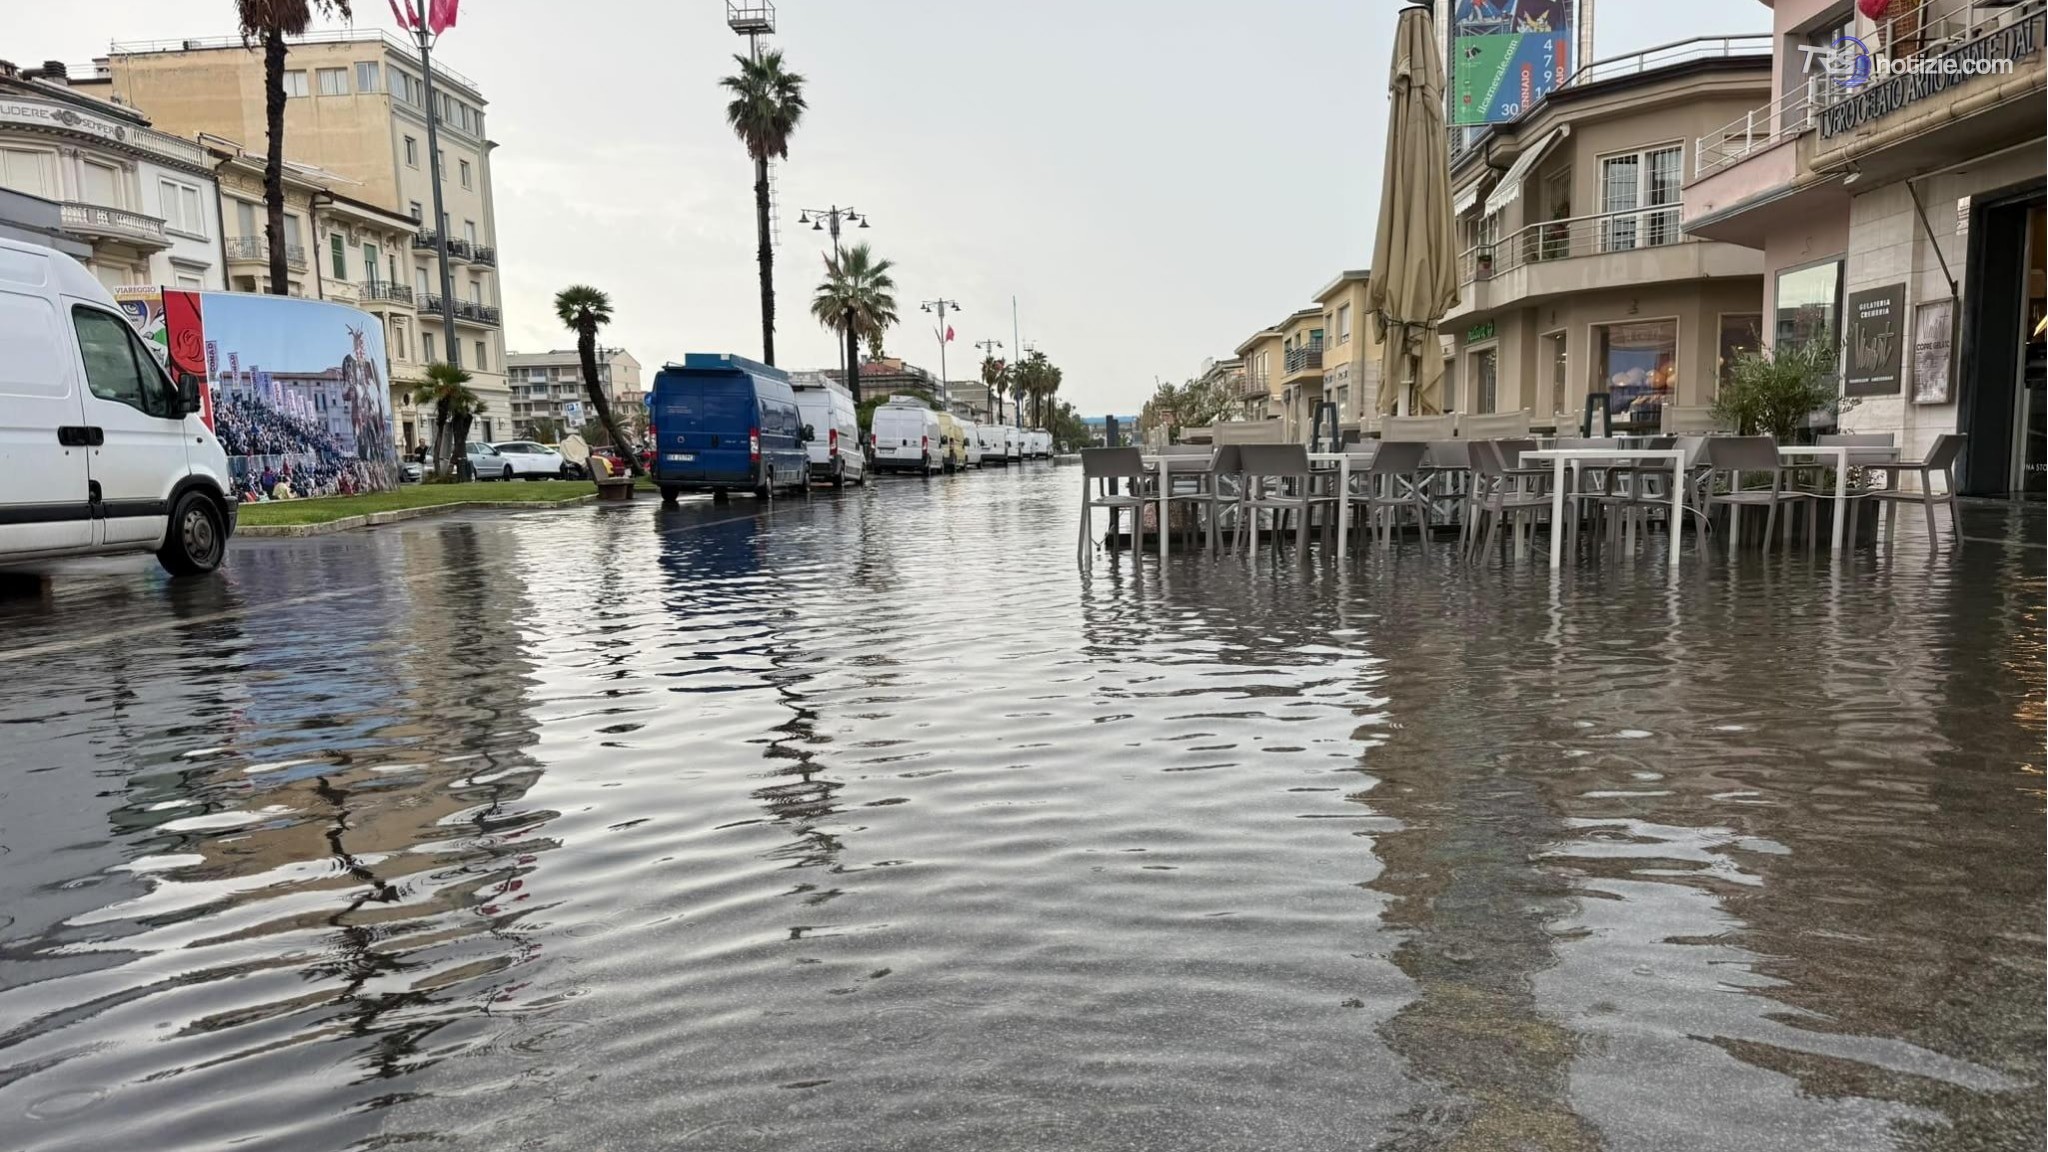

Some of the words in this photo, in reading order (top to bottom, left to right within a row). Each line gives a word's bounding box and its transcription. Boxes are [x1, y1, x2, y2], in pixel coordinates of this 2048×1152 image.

[1543, 39, 1553, 51] 4
[1543, 55, 1553, 67] 7
[1477, 40, 1519, 114] ilcarnevale.com
[1543, 71, 1553, 83] 9
[1825, 99, 1856, 137] VERO
[1857, 77, 1905, 123] GELATO
[2002, 21, 2037, 62] DAL
[1501, 103, 1519, 116] 30
[82, 119, 115, 135] SEMPER
[115, 286, 156, 294] VIAREGGIO
[1859, 299, 1891, 311] GELATERIA
[1860, 308, 1890, 319] CREMERIA
[207, 343, 216, 373] CONAD
